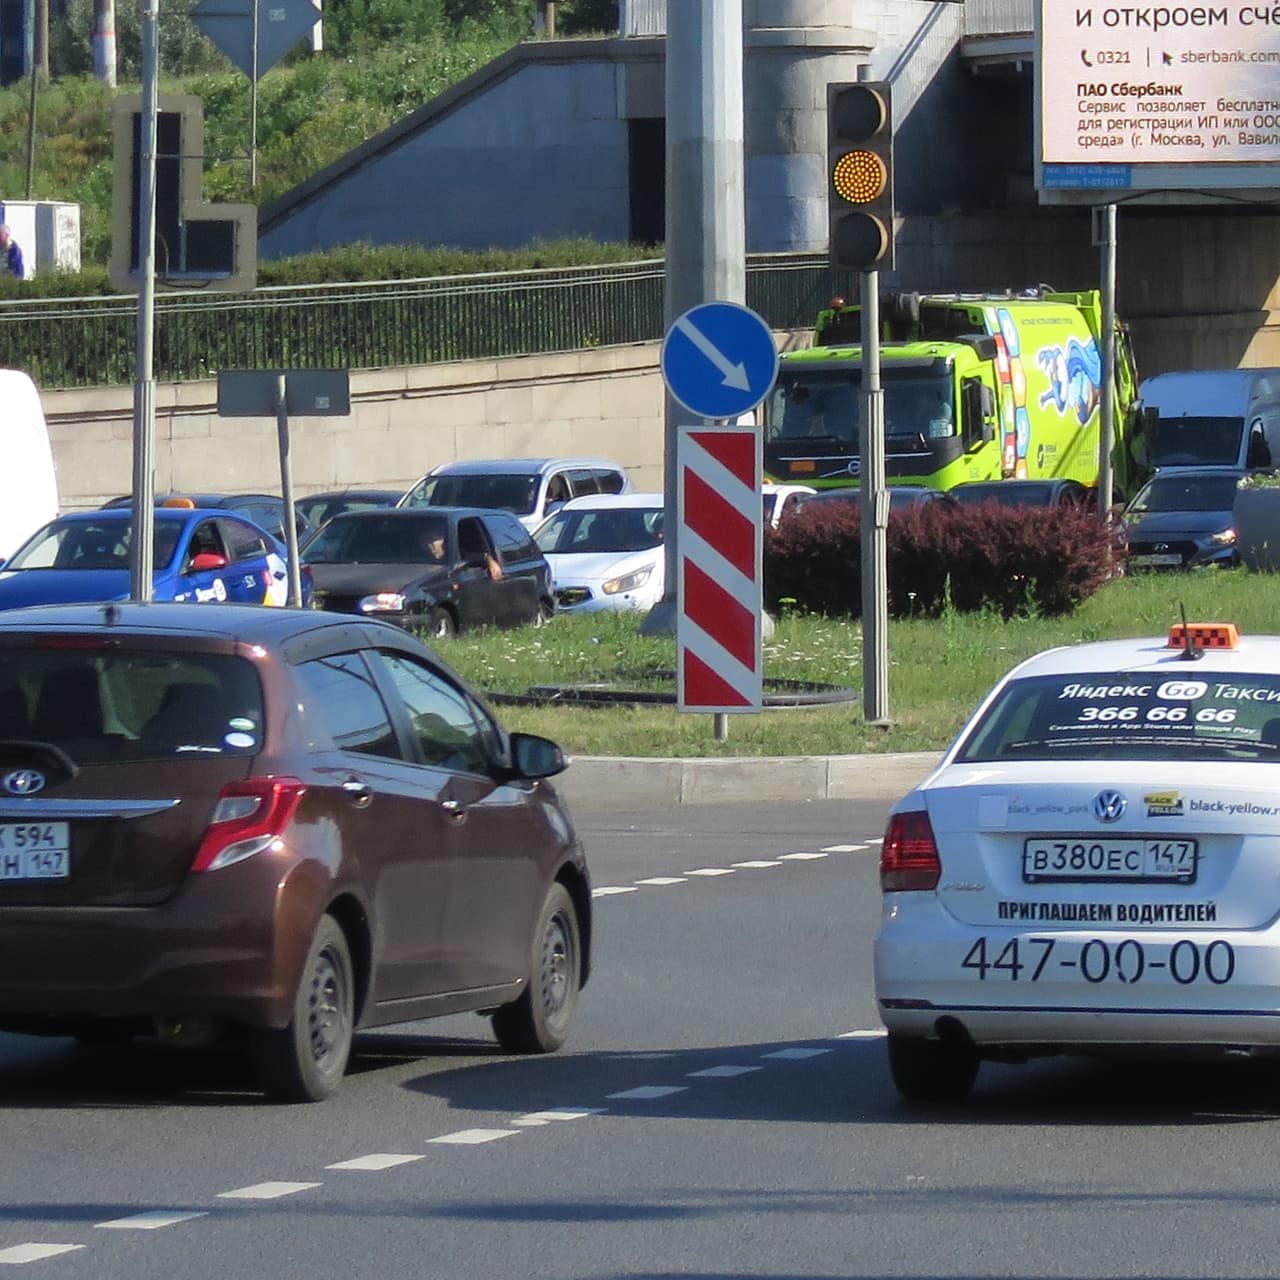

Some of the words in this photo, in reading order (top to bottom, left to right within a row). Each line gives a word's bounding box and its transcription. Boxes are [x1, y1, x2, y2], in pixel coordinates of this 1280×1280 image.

[1075, 8, 1092, 27] и
[1103, 6, 1228, 32] откроем
[1096, 51, 1131, 64] 0321
[1077, 83, 1107, 97] ПАО
[1111, 81, 1182, 99] Сбербанк
[1078, 100, 1126, 116] Сервис
[1136, 101, 1206, 113] позволяет
[1077, 118, 1102, 131] для
[1107, 117, 1193, 133] регистрации
[1198, 114, 1218, 128] ИП
[1223, 118, 1249, 129] или
[1077, 134, 1124, 149] среда»
[1131, 133, 1143, 148] (г.
[1151, 133, 1204, 148] Москва,
[1212, 134, 1230, 149] ул.
[1058, 683, 1152, 699] Яндекс
[1163, 682, 1203, 698] Go
[1078, 707, 1139, 722] 366
[1146, 707, 1188, 722] 66
[1195, 708, 1237, 724] 66
[14, 826, 55, 847] 594
[1033, 844, 1141, 871] В380ЕС
[1149, 843, 1189, 864] 147
[998, 901, 1112, 921] ПРИГЛАШАЕМ
[1117, 900, 1217, 924] ВОДИТЕЛЕЙ
[960, 936, 1236, 984] 447-00-00
